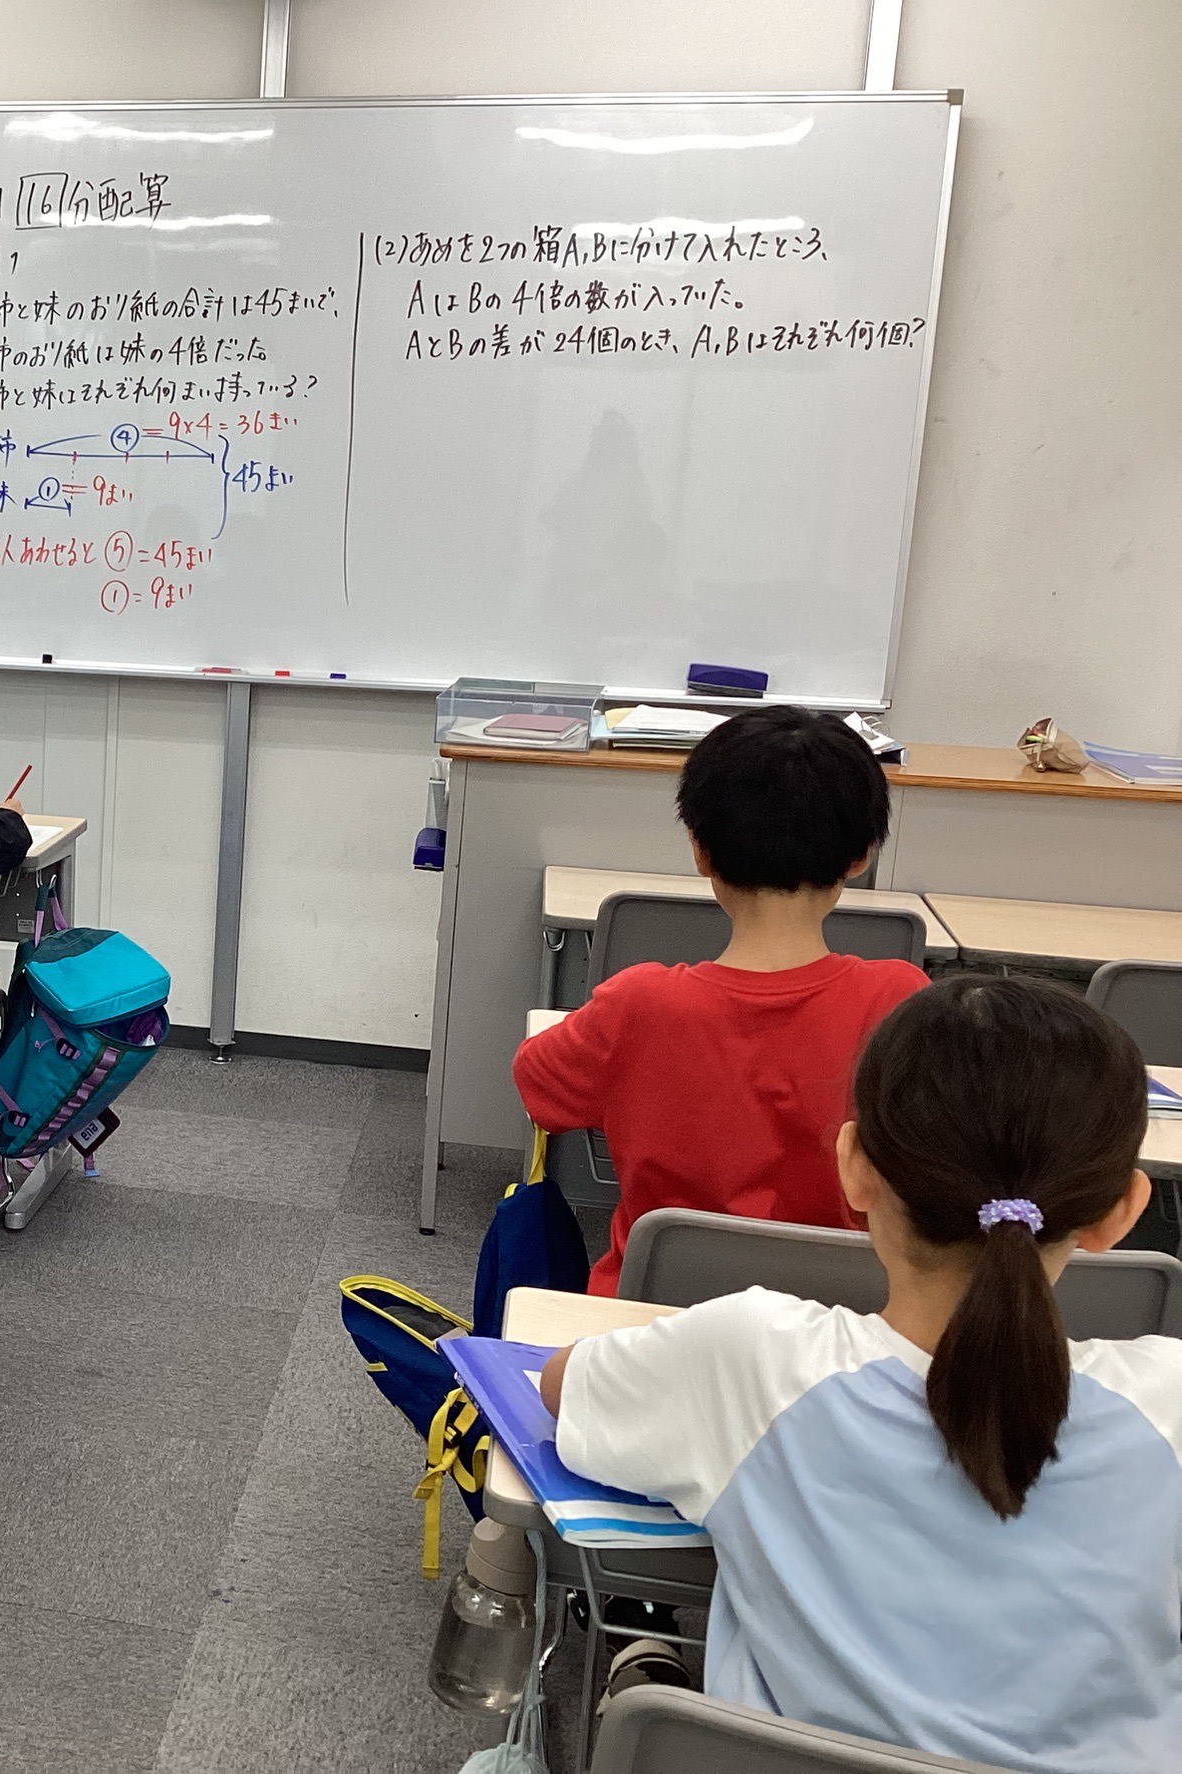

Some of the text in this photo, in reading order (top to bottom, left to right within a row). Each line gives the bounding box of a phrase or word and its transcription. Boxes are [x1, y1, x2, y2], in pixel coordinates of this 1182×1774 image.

[67, 172, 172, 229] 分配算
[232, 460, 294, 493] 45まい
